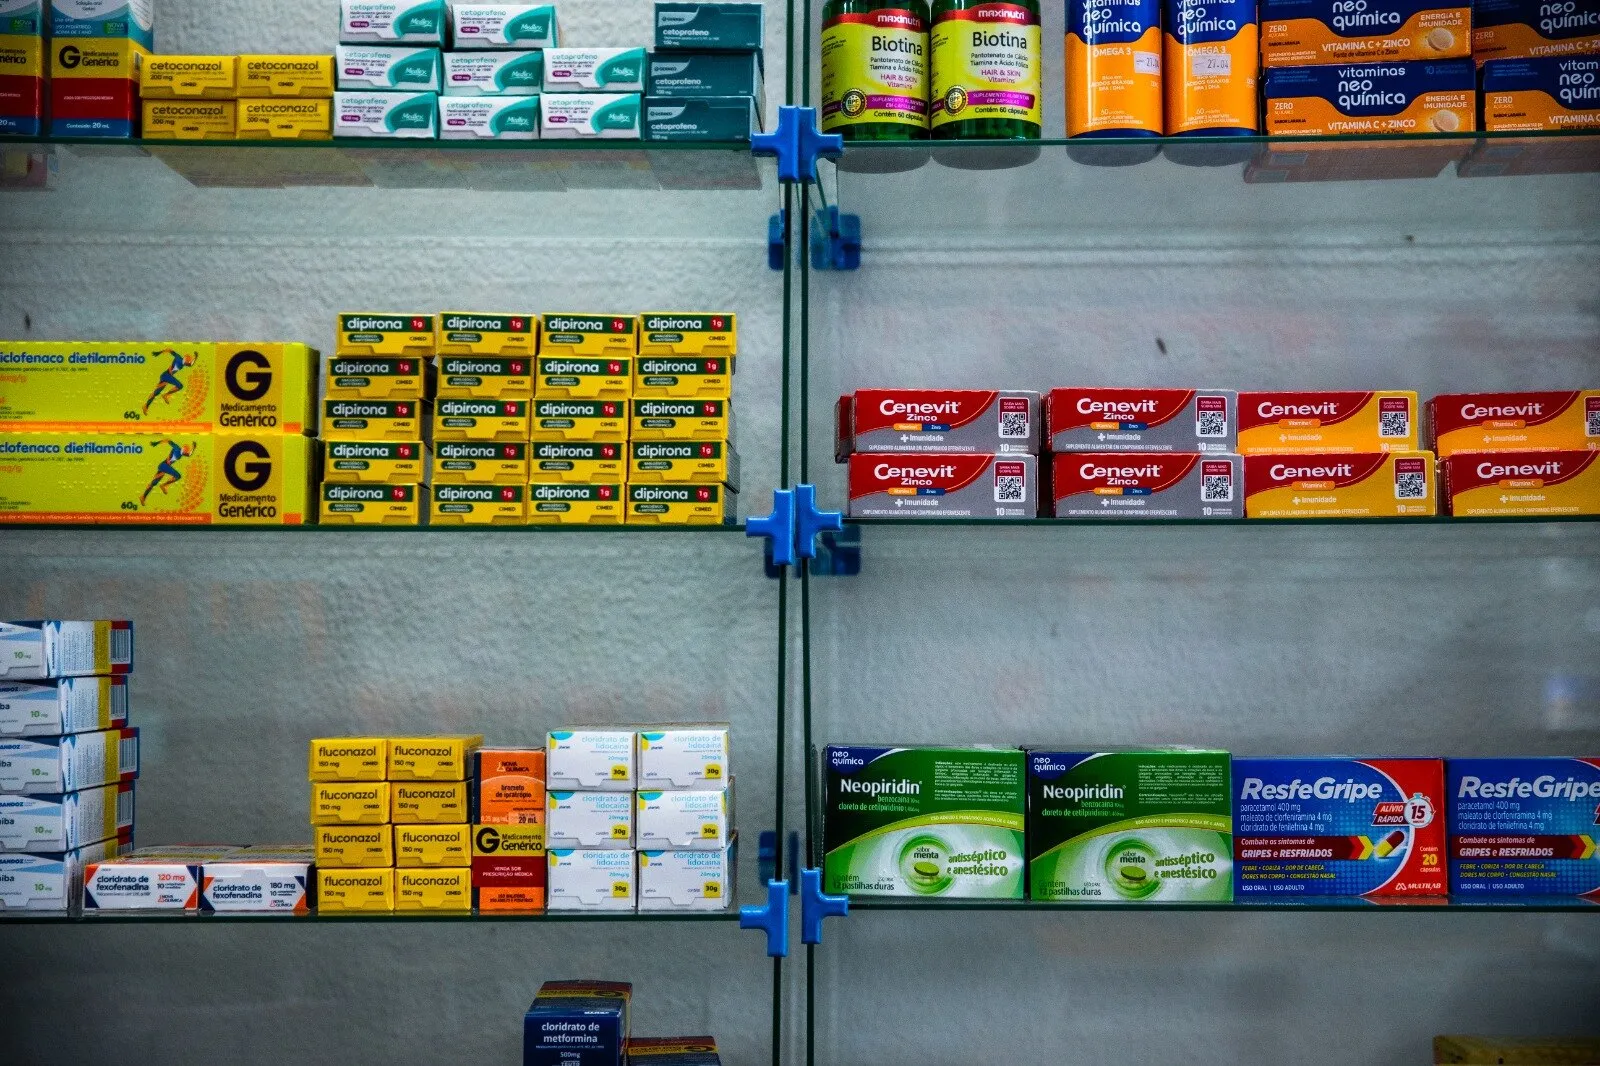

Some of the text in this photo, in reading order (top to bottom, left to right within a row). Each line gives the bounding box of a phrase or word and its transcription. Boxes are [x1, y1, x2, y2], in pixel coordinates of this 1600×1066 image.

[350, 4, 395, 12] cetoprofeno
[1333, 0, 1367, 13] neo
[878, 15, 921, 26] maxinutri
[978, 9, 1025, 20] maxinutri
[1420, 12, 1454, 21] ENERGIA
[1178, 18, 1236, 37] química
[1333, 13, 1400, 30] química
[1418, 19, 1463, 27] IMUNIDADE
[1083, 19, 1141, 39] química
[872, 36, 923, 56] Biotina
[972, 32, 1027, 49] Biotina
[1322, 42, 1366, 51] VITAMINA
[1382, 39, 1410, 47] ZINCO
[59, 45, 80, 69] G
[1093, 48, 1126, 57] OMEGA
[150, 61, 222, 71] cetoconazol
[247, 61, 318, 71] cetoconazol
[1338, 67, 1406, 78] vitaminas
[1559, 73, 1594, 85] neo
[1338, 80, 1372, 92] neo
[1338, 92, 1406, 110] química
[152, 105, 224, 116] cetoconazol
[246, 103, 318, 113] cetoconazol
[1328, 122, 1372, 130] VITAMINA
[1388, 120, 1415, 128] ZINCO
[549, 318, 603, 332] dipirona
[0, 352, 145, 364] iclofenaco dietilamônio
[335, 361, 389, 374] dipirona
[225, 350, 272, 401] G
[333, 403, 387, 416] dipirona
[442, 402, 496, 416] dipirona
[641, 402, 694, 416] dipirona
[880, 399, 959, 415] Cenevit
[1077, 398, 1156, 414] Cenevit
[1258, 402, 1337, 418] Cenevit
[1461, 403, 1542, 419] Cenevit
[124, 411, 140, 420] 60g
[220, 411, 277, 427] Genérico
[64, 442, 143, 454] dietilamônio
[334, 444, 389, 458] dipirona
[441, 445, 495, 458] dipirona
[539, 445, 593, 458] dipirona
[224, 440, 272, 492] G
[874, 464, 954, 480] Cenevit
[1080, 464, 1160, 480] Cenevit
[1270, 464, 1352, 480] Cenevit
[1477, 462, 1560, 478] Cenevit
[219, 493, 276, 502] Medicamento
[439, 487, 493, 501] dipirona
[121, 501, 137, 511] 60g
[218, 502, 277, 518] Genérico
[319, 747, 376, 757] fluconazol
[394, 746, 451, 757] fluconazol
[398, 789, 455, 799] fluconazol
[840, 779, 920, 797] Neopiridin
[1043, 784, 1123, 802] Neopiridin
[1241, 777, 1382, 803] ResfeGripe
[1458, 776, 1600, 801] ResfeGripe
[320, 790, 378, 800] fluconazol
[1291, 805, 1300, 813] mg
[1380, 805, 1403, 813] ALÍVIO
[1411, 805, 1425, 819] 15
[1274, 813, 1315, 821] clorfeniramina
[1323, 814, 1332, 822] mg
[1377, 814, 1404, 823] RÁPIDO
[1278, 823, 1308, 831] fenilefrina
[1309, 823, 1313, 831] 4
[1315, 824, 1324, 832] mg
[323, 833, 381, 843] fluconazol
[402, 833, 460, 842] fluconazol
[476, 827, 500, 853] G
[501, 839, 542, 851] Genérico
[948, 850, 1006, 864] antisséptico
[1242, 850, 1271, 858] GRIPES
[1280, 849, 1332, 858] RESFRIADOS
[1460, 848, 1490, 857] GRIPES
[1499, 848, 1553, 856] RESFRIADOS
[1155, 852, 1215, 868] antisséptico
[1423, 854, 1437, 865] 20
[953, 863, 1008, 876] anestésico
[1161, 867, 1217, 879] anestésico
[324, 876, 382, 886] fluconazol
[402, 876, 460, 886] fluconazol
[842, 882, 894, 890] pastilhas duras
[96, 884, 149, 892] fexofenadina
[213, 884, 262, 892] cloridrato de
[1049, 888, 1101, 896] pastilhas duras
[213, 892, 262, 900] fexofenadina
[542, 1022, 599, 1031] cloridrato de
[543, 1034, 598, 1043] metformina
